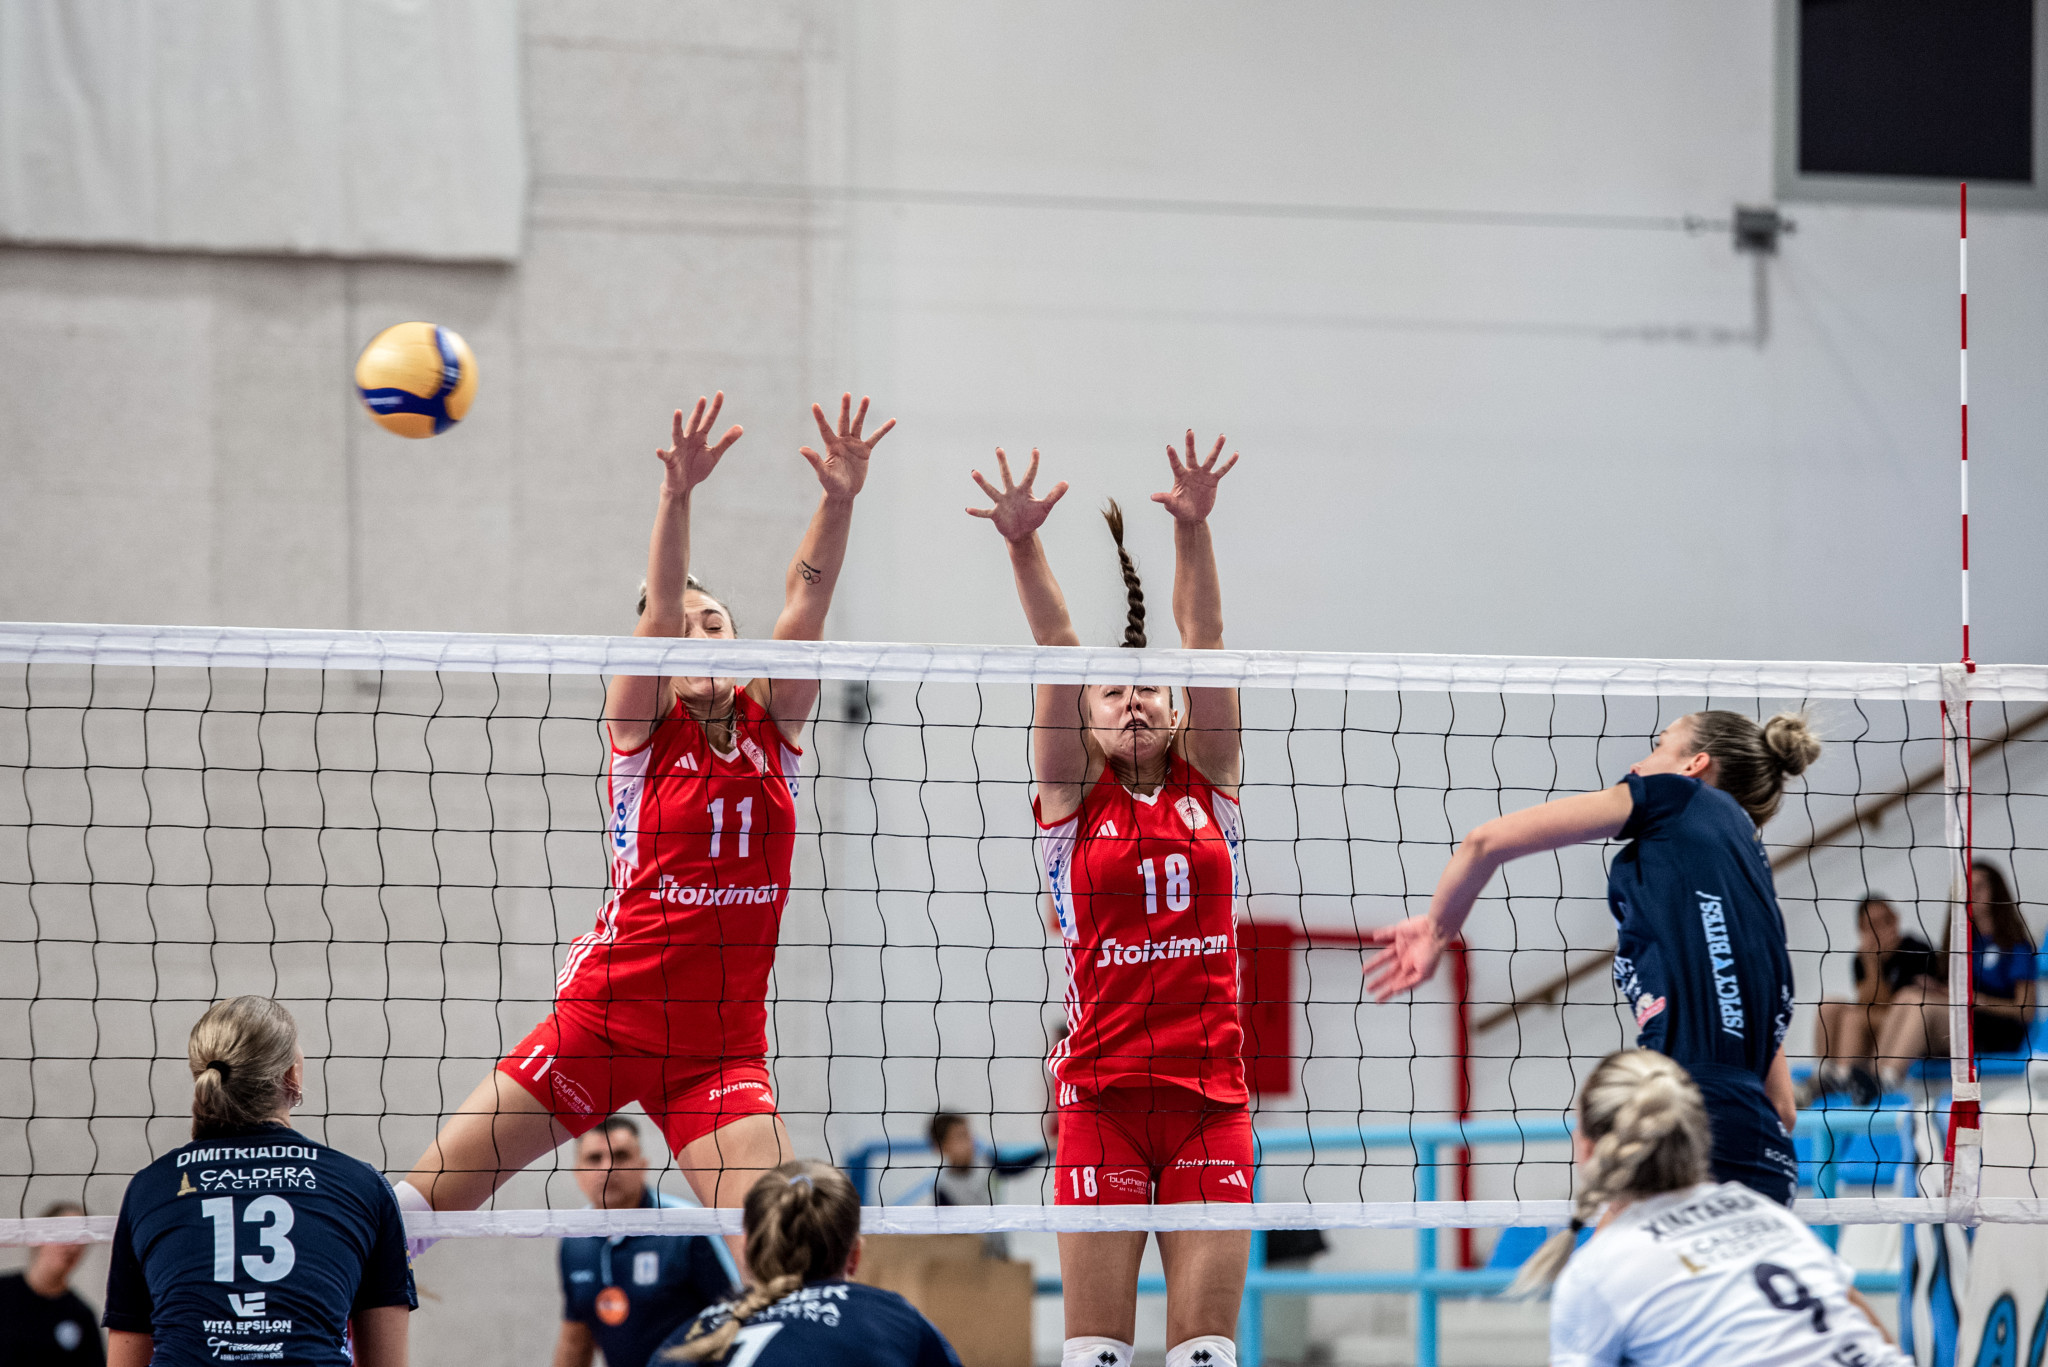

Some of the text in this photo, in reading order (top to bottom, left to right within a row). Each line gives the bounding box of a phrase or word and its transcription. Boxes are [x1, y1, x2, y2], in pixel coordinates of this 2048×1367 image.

[706, 796, 753, 858] 11
[649, 874, 779, 906] Stoiximan
[1136, 853, 1191, 915] 18
[1096, 933, 1228, 968] Stoiximan
[518, 1044, 557, 1082] 11
[708, 1081, 764, 1101] Stoiximan
[176, 1145, 318, 1168] DIMITRIADOU
[1175, 1158, 1236, 1170] Stoiximan
[200, 1167, 316, 1181] CALDERA
[200, 1178, 317, 1191] YACHTING
[1069, 1166, 1098, 1200] 18
[201, 1194, 296, 1283] 13
[1754, 1262, 1830, 1334] 9
[203, 1320, 292, 1331] VITA EPSILON
